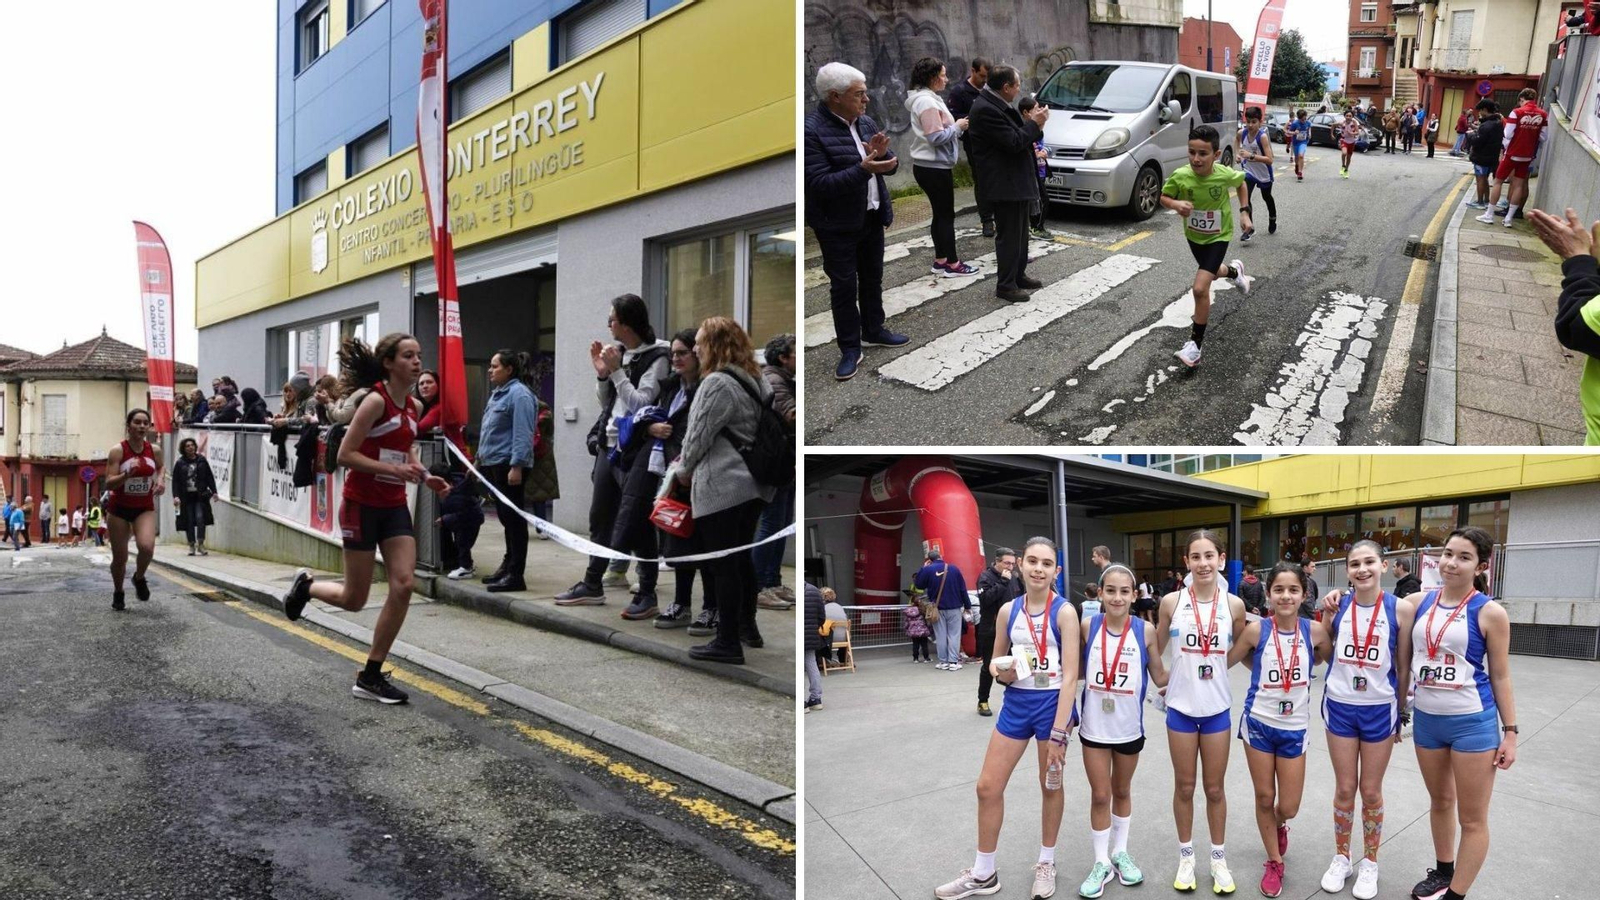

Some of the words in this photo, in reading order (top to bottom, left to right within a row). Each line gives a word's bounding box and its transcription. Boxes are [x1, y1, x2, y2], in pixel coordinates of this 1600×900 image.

[1254, 40, 1266, 76] CONCELLO
[1263, 45, 1271, 62] VIGO
[1261, 63, 1268, 73] DE
[331, 168, 413, 230] COLEXIO
[420, 71, 606, 194] NTERREY
[340, 224, 379, 253] CENTRO
[382, 193, 461, 237] CONCERO
[474, 141, 585, 203] PLURILINGÜE
[1191, 217, 1215, 230] 037
[363, 237, 407, 265] INFANTIL
[417, 210, 478, 249] PRARIA
[267, 454, 295, 477] CONLL
[128, 484, 149, 493] 028
[271, 478, 280, 497] DE
[281, 481, 299, 503] VIGO
[1032, 657, 1049, 671] 49
